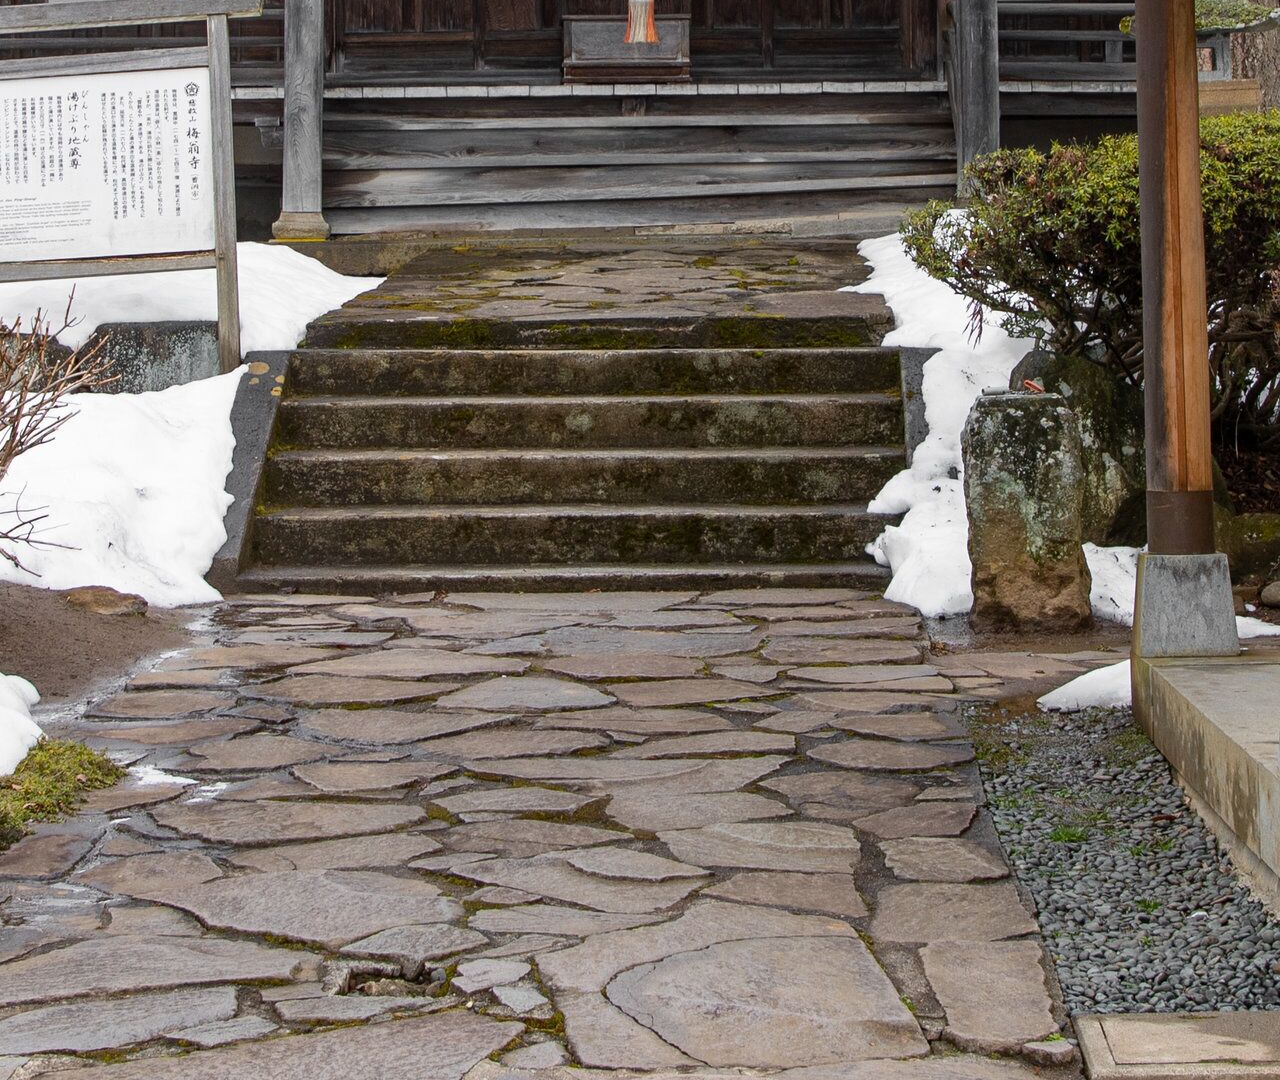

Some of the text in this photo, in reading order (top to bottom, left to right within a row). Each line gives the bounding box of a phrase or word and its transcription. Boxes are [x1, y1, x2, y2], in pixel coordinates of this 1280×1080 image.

[67, 92, 82, 170] 湯けぶり地蔵尊
[186, 126, 201, 170] 梅翁寺
